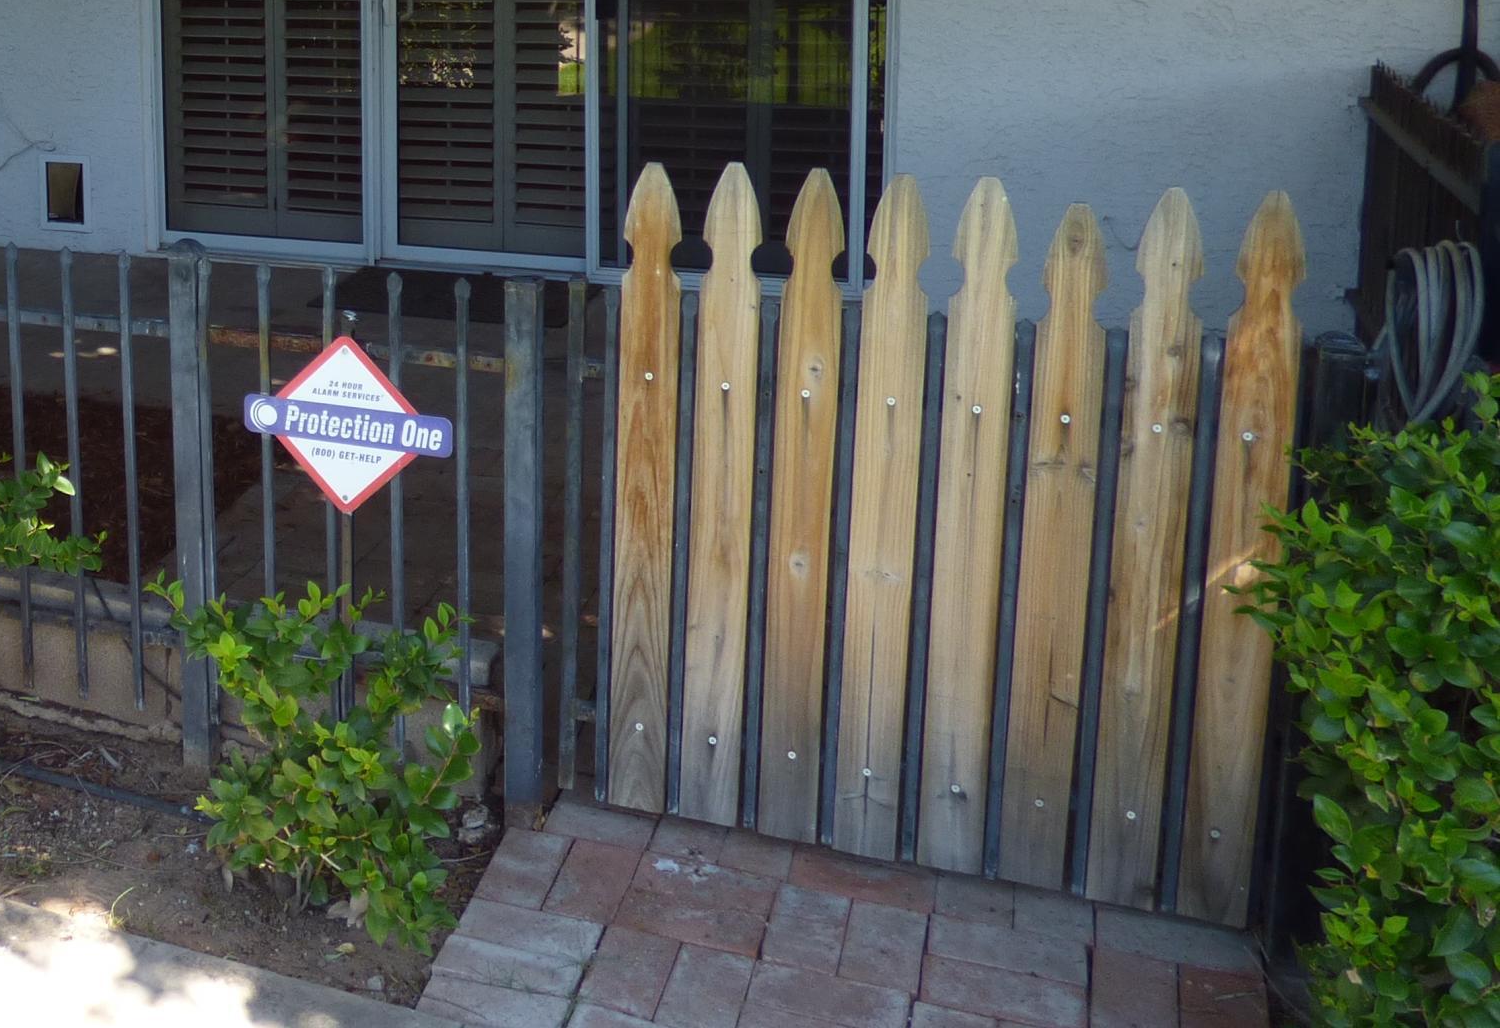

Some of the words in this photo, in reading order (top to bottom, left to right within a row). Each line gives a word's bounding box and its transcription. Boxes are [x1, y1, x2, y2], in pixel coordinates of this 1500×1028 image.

[328, 380, 339, 388] 24
[341, 381, 363, 390] HOUR
[312, 387, 340, 397] ALARM
[342, 390, 381, 402] SERVICES
[284, 405, 395, 445] Protection
[401, 419, 444, 452] One
[311, 447, 336, 460] (800)
[338, 449, 382, 465] GET-HELP
